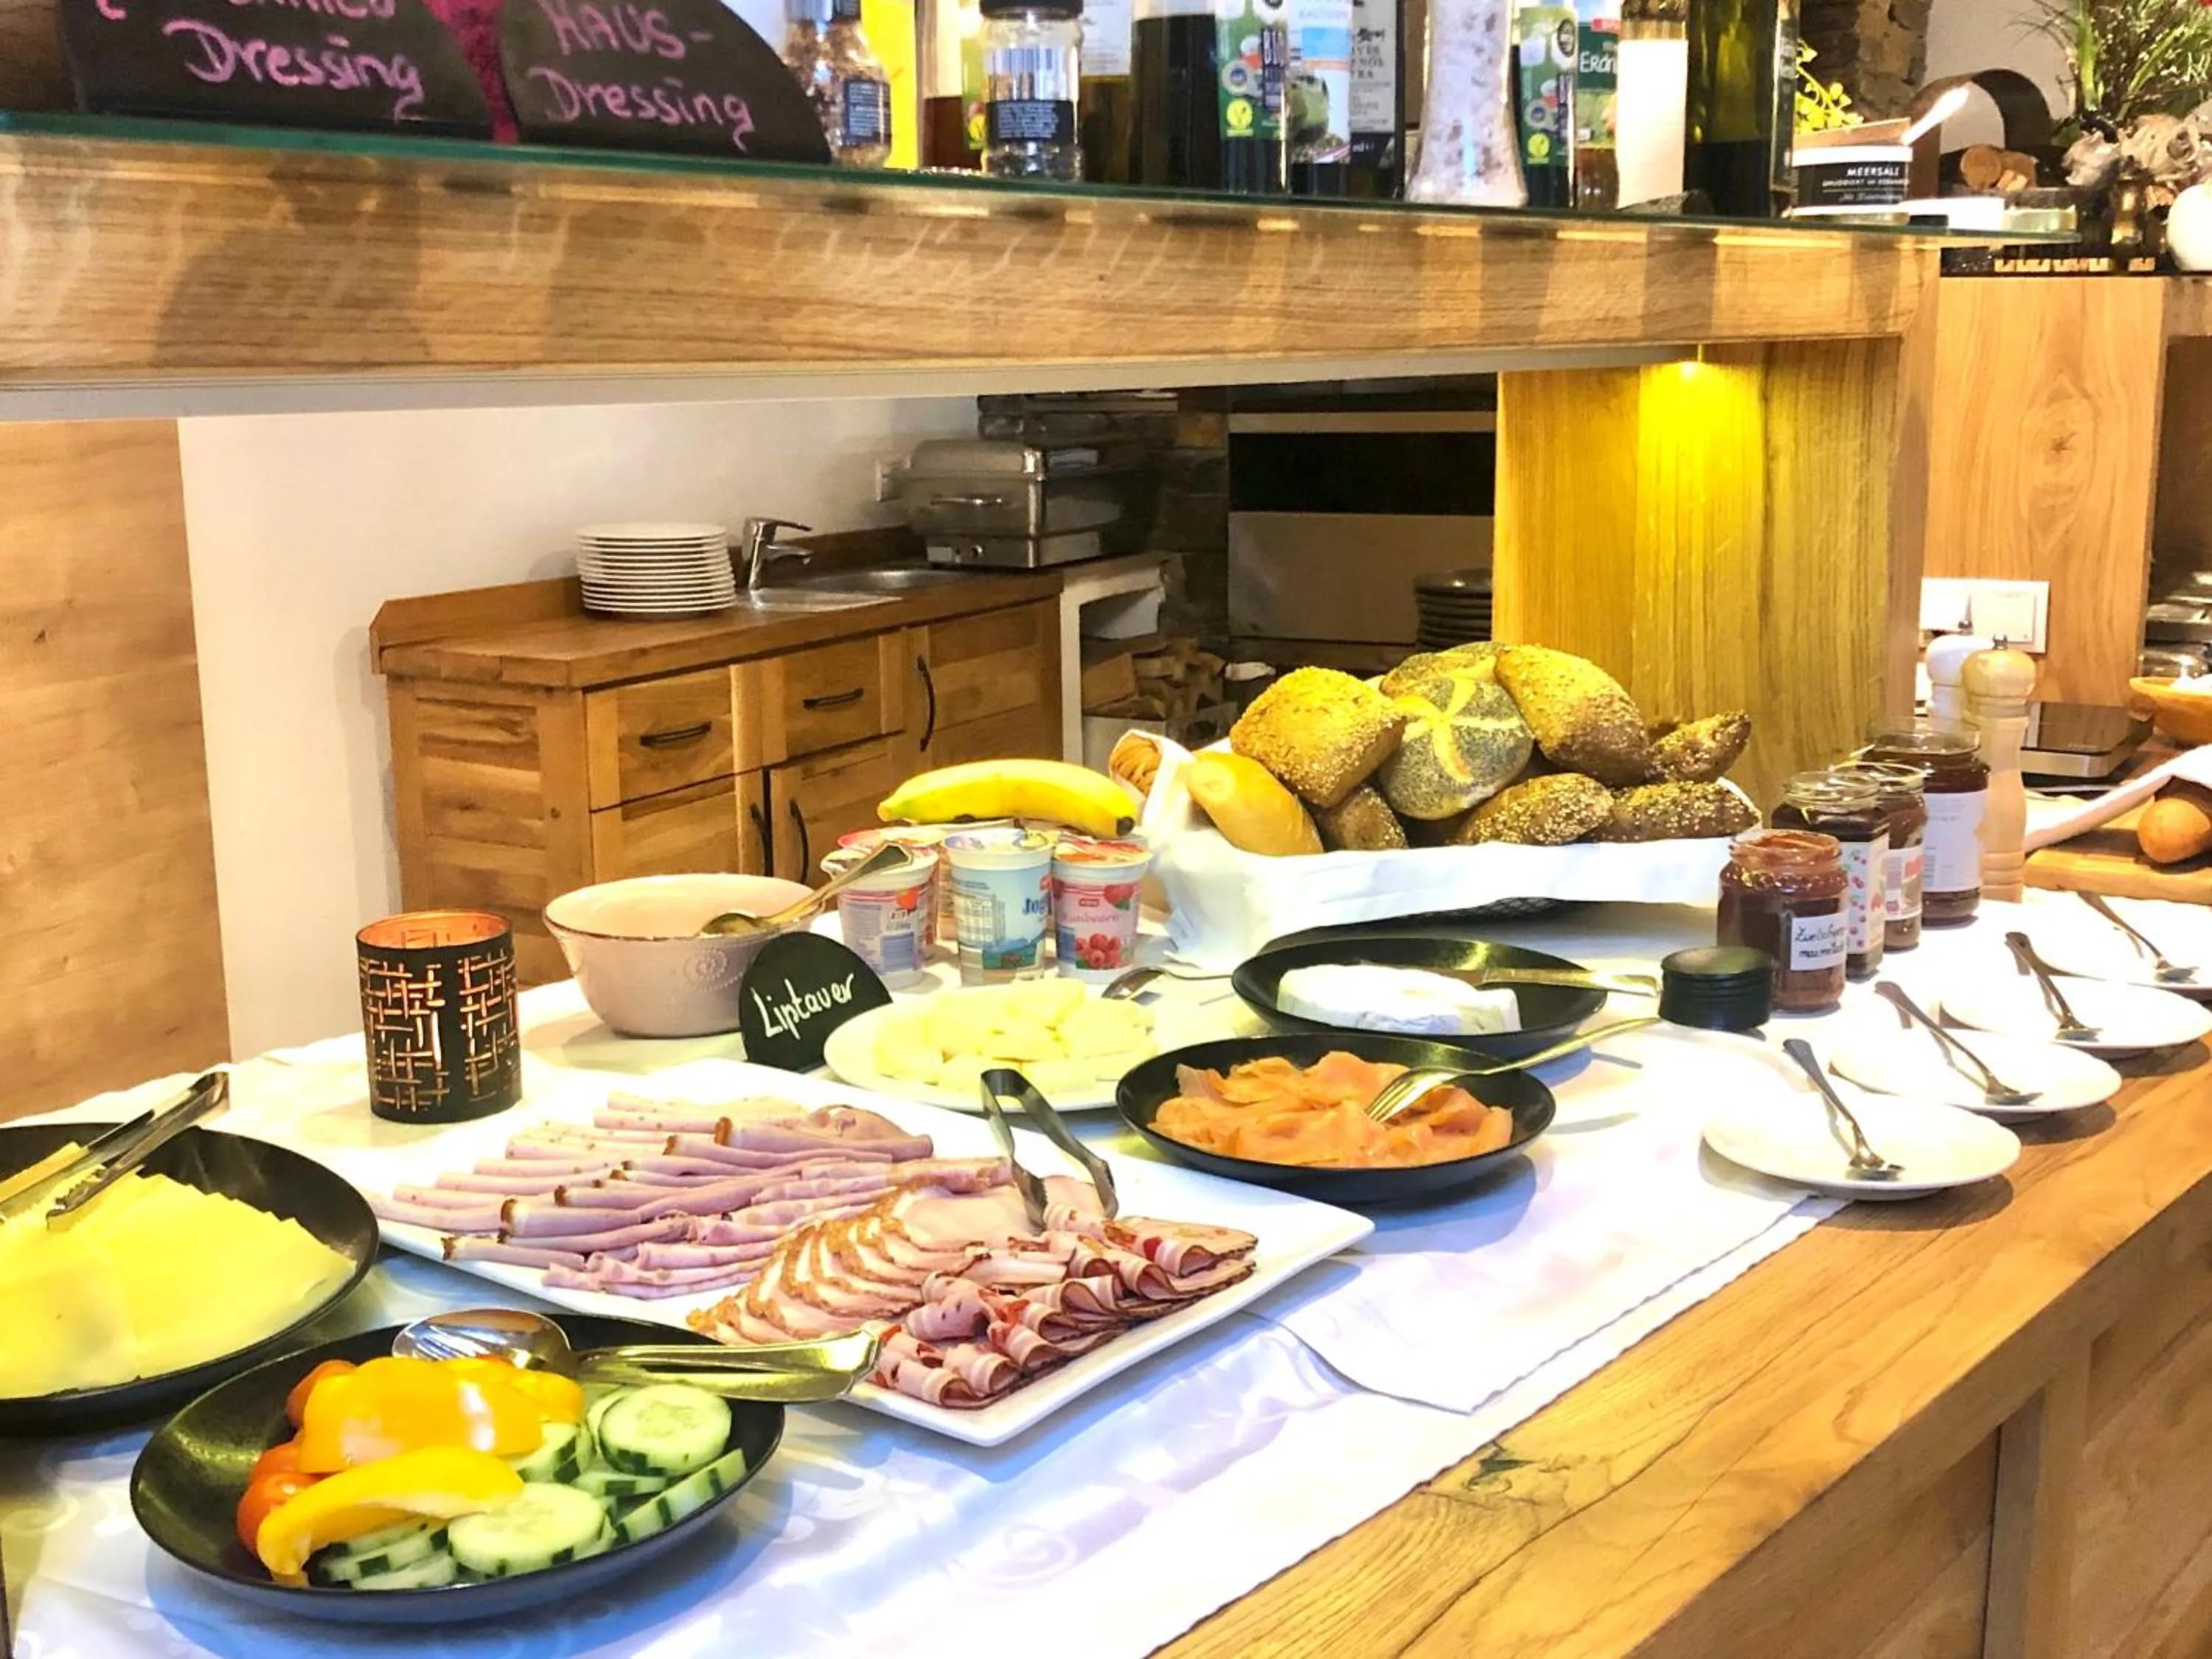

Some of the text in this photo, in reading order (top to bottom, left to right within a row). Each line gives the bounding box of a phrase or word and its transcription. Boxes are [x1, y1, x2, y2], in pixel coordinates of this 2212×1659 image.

[538, 0, 714, 60] HAUS-
[162, 19, 425, 125] Dressing
[526, 66, 756, 154] Dressing
[751, 973, 855, 1040] Liptauer
